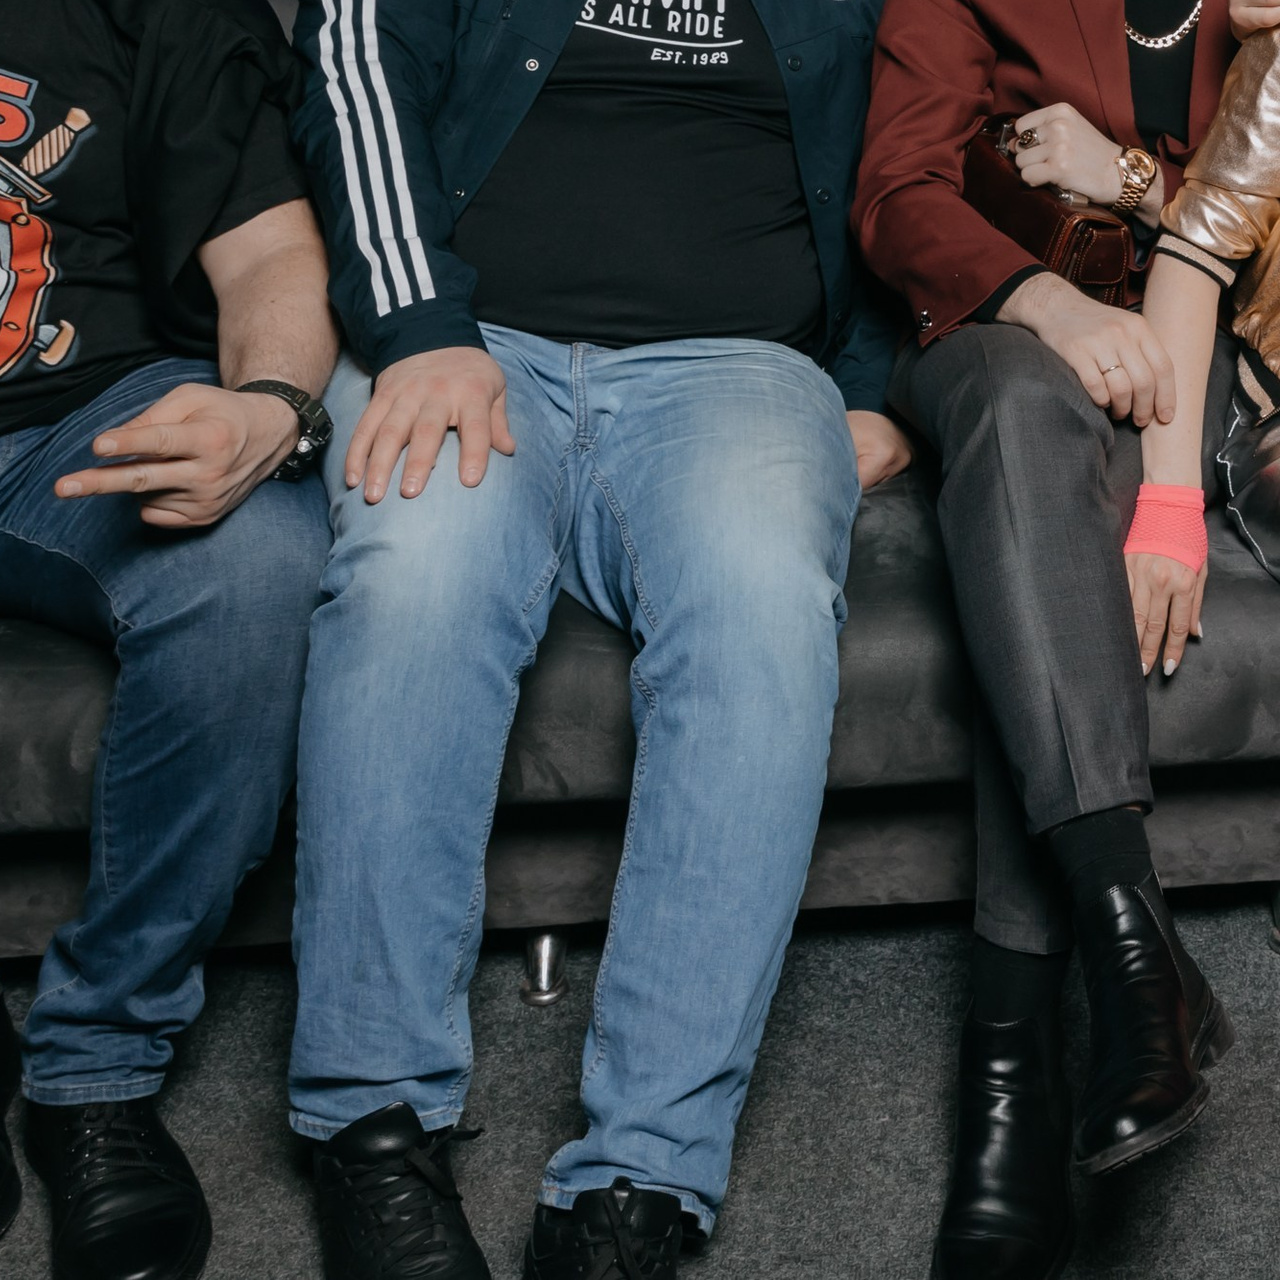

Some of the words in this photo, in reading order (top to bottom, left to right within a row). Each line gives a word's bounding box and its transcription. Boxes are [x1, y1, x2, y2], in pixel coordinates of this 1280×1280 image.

[608, 3, 652, 29] ALL
[667, 10, 725, 39] RIDE
[650, 48, 686, 65] EST.
[692, 51, 729, 66] 1989
